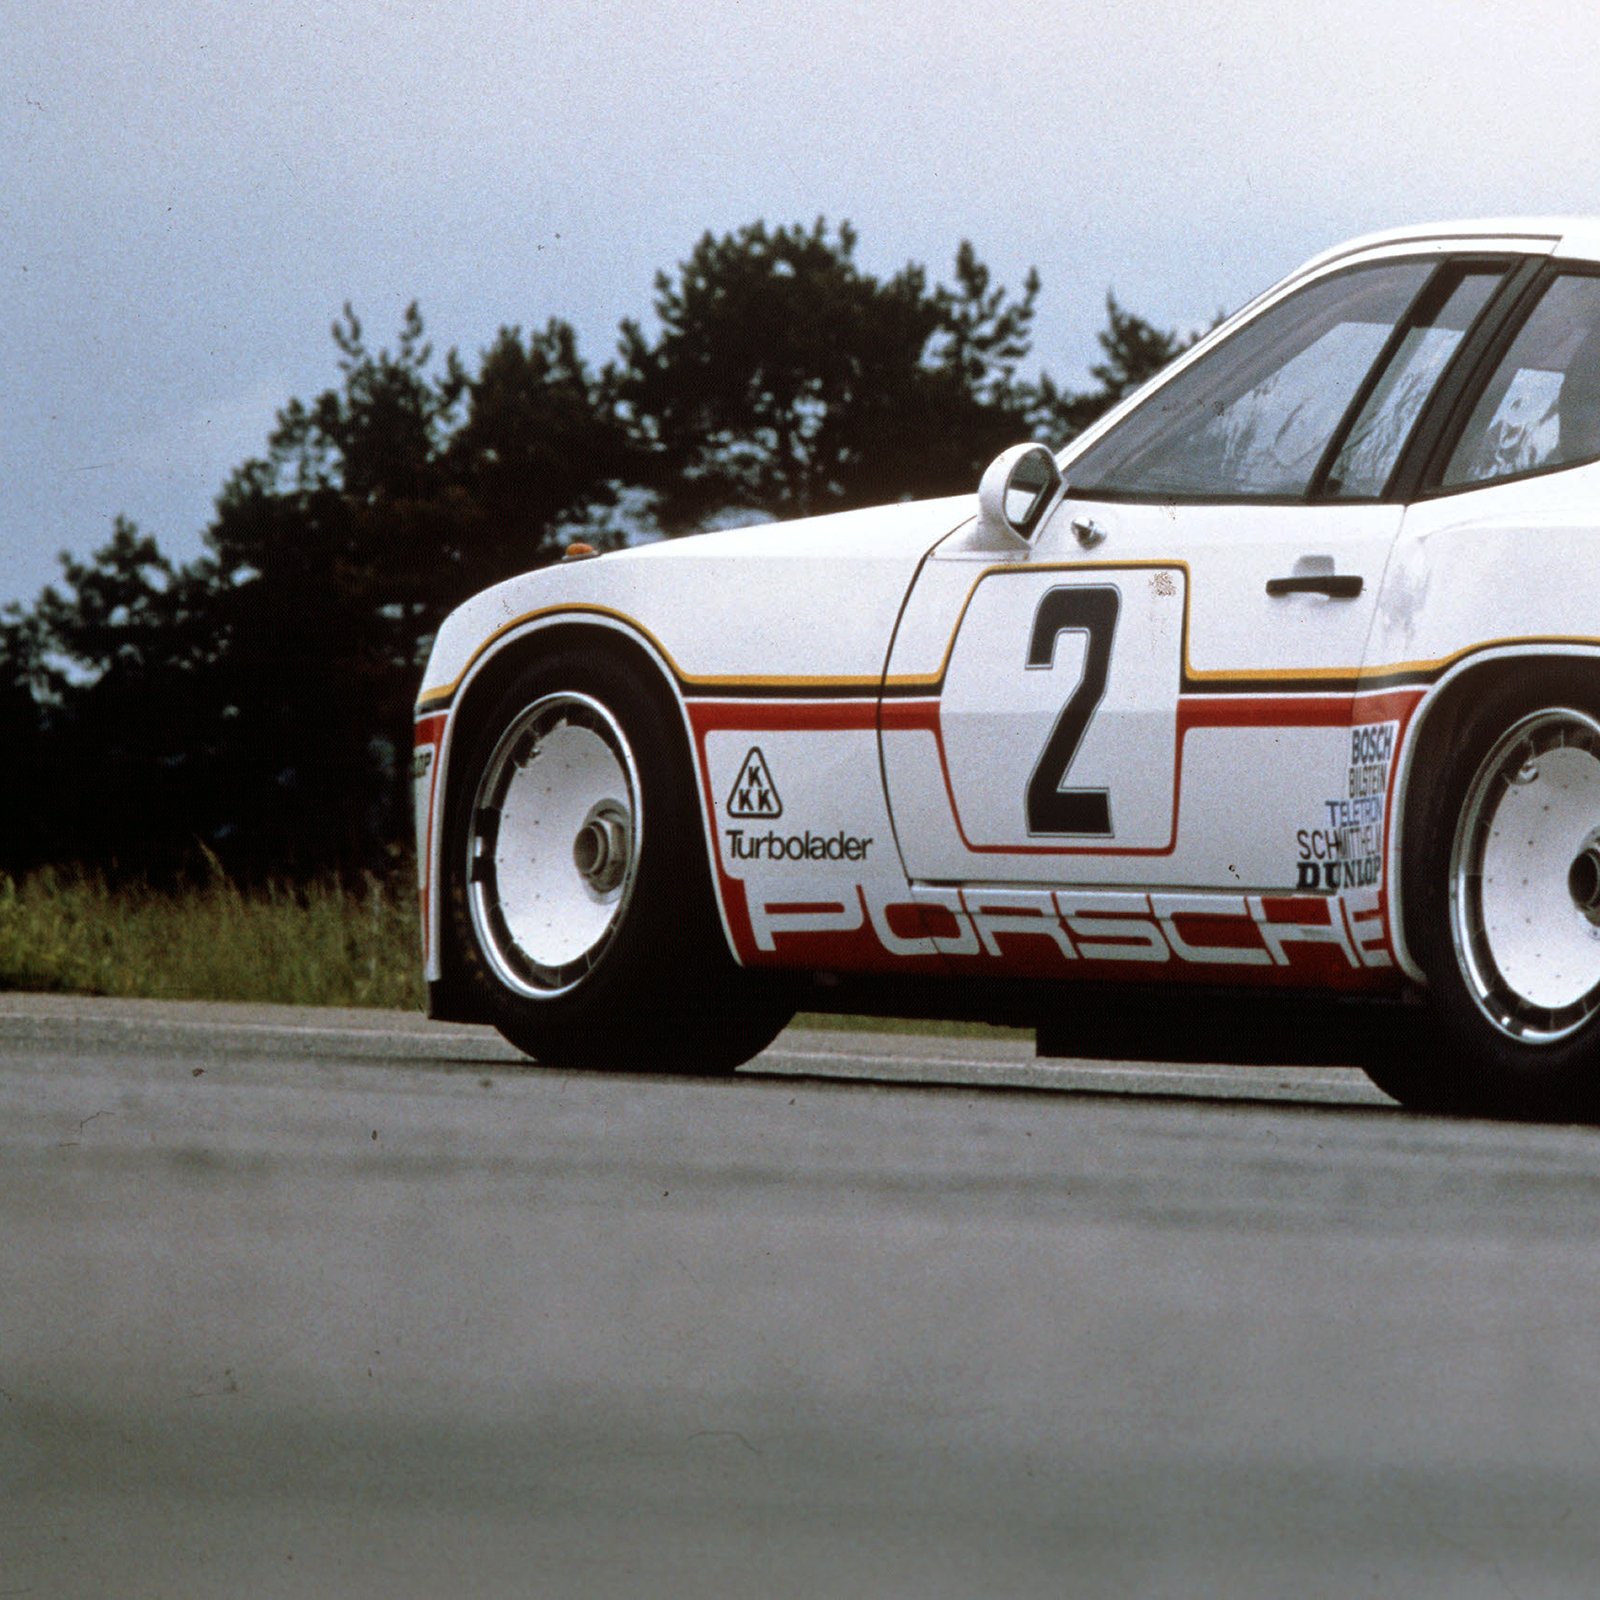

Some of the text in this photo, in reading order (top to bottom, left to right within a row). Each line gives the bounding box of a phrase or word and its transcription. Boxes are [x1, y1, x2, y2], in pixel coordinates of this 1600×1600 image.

[1025, 583, 1122, 837] 2
[1352, 725, 1393, 764] BOSCH
[1348, 764, 1387, 799] BILSTEIN
[725, 829, 873, 860] Turbolader
[1296, 855, 1382, 891] DUNLOP
[743, 882, 1394, 968] PORSCHE
